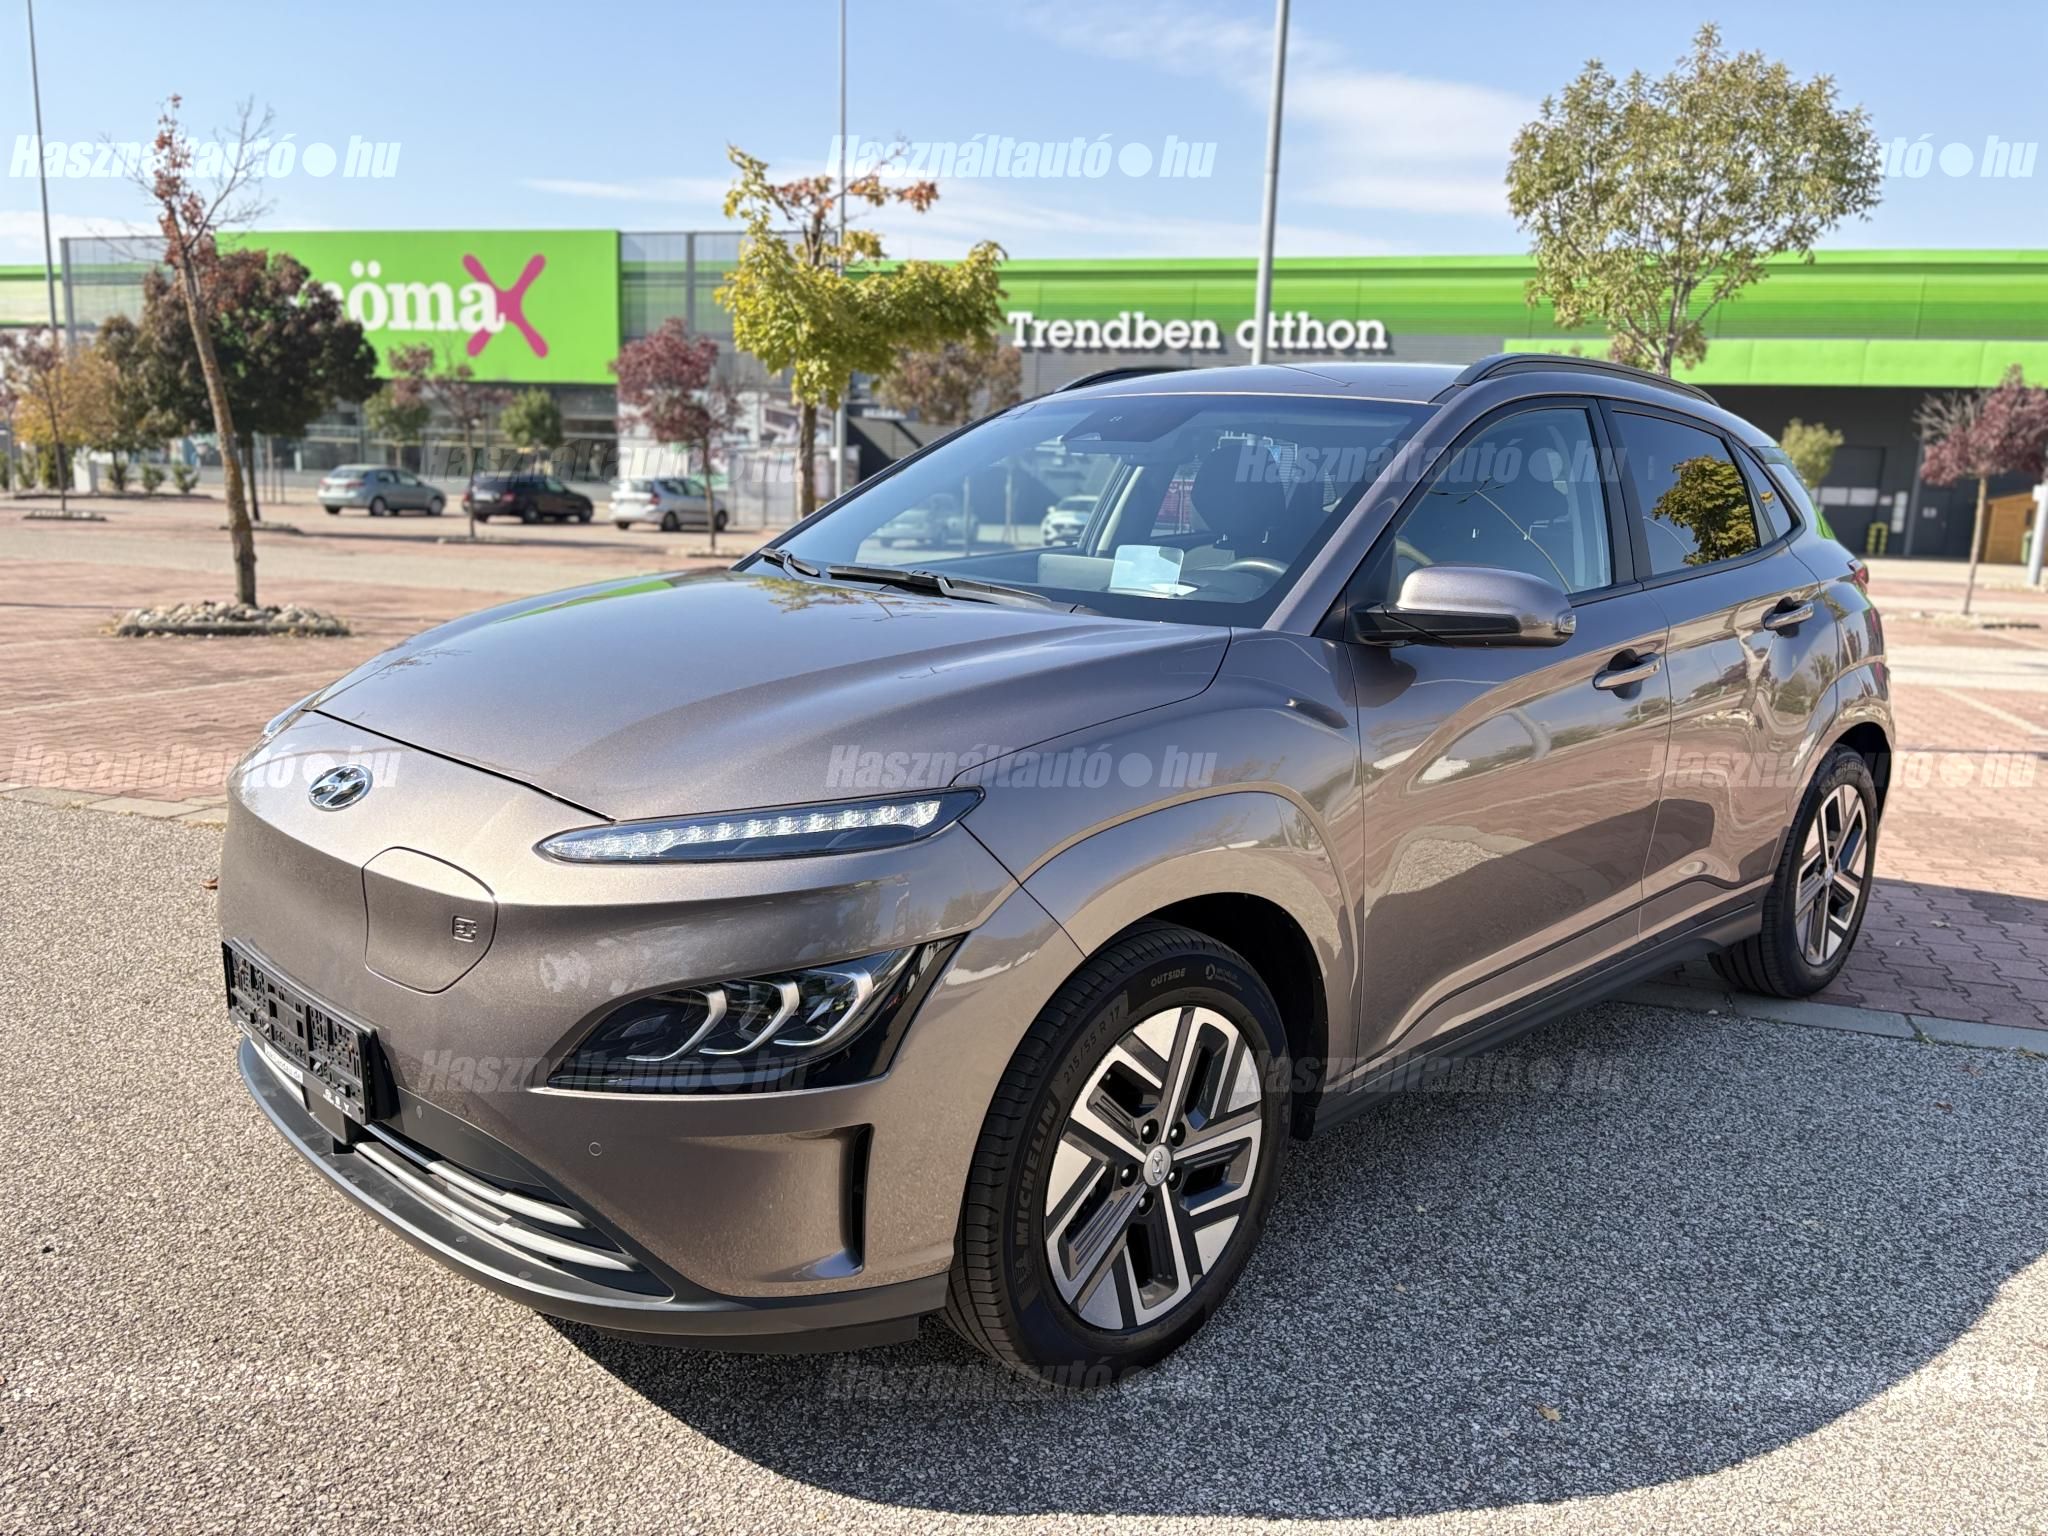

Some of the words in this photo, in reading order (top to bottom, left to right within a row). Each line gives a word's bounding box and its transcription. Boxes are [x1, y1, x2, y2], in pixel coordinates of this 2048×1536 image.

[1007, 311, 1221, 350] Trendben
[1236, 311, 1388, 350] otthon
[1150, 967, 1187, 988] OUTSIDE
[1015, 1099, 1058, 1246] MICHELIN
